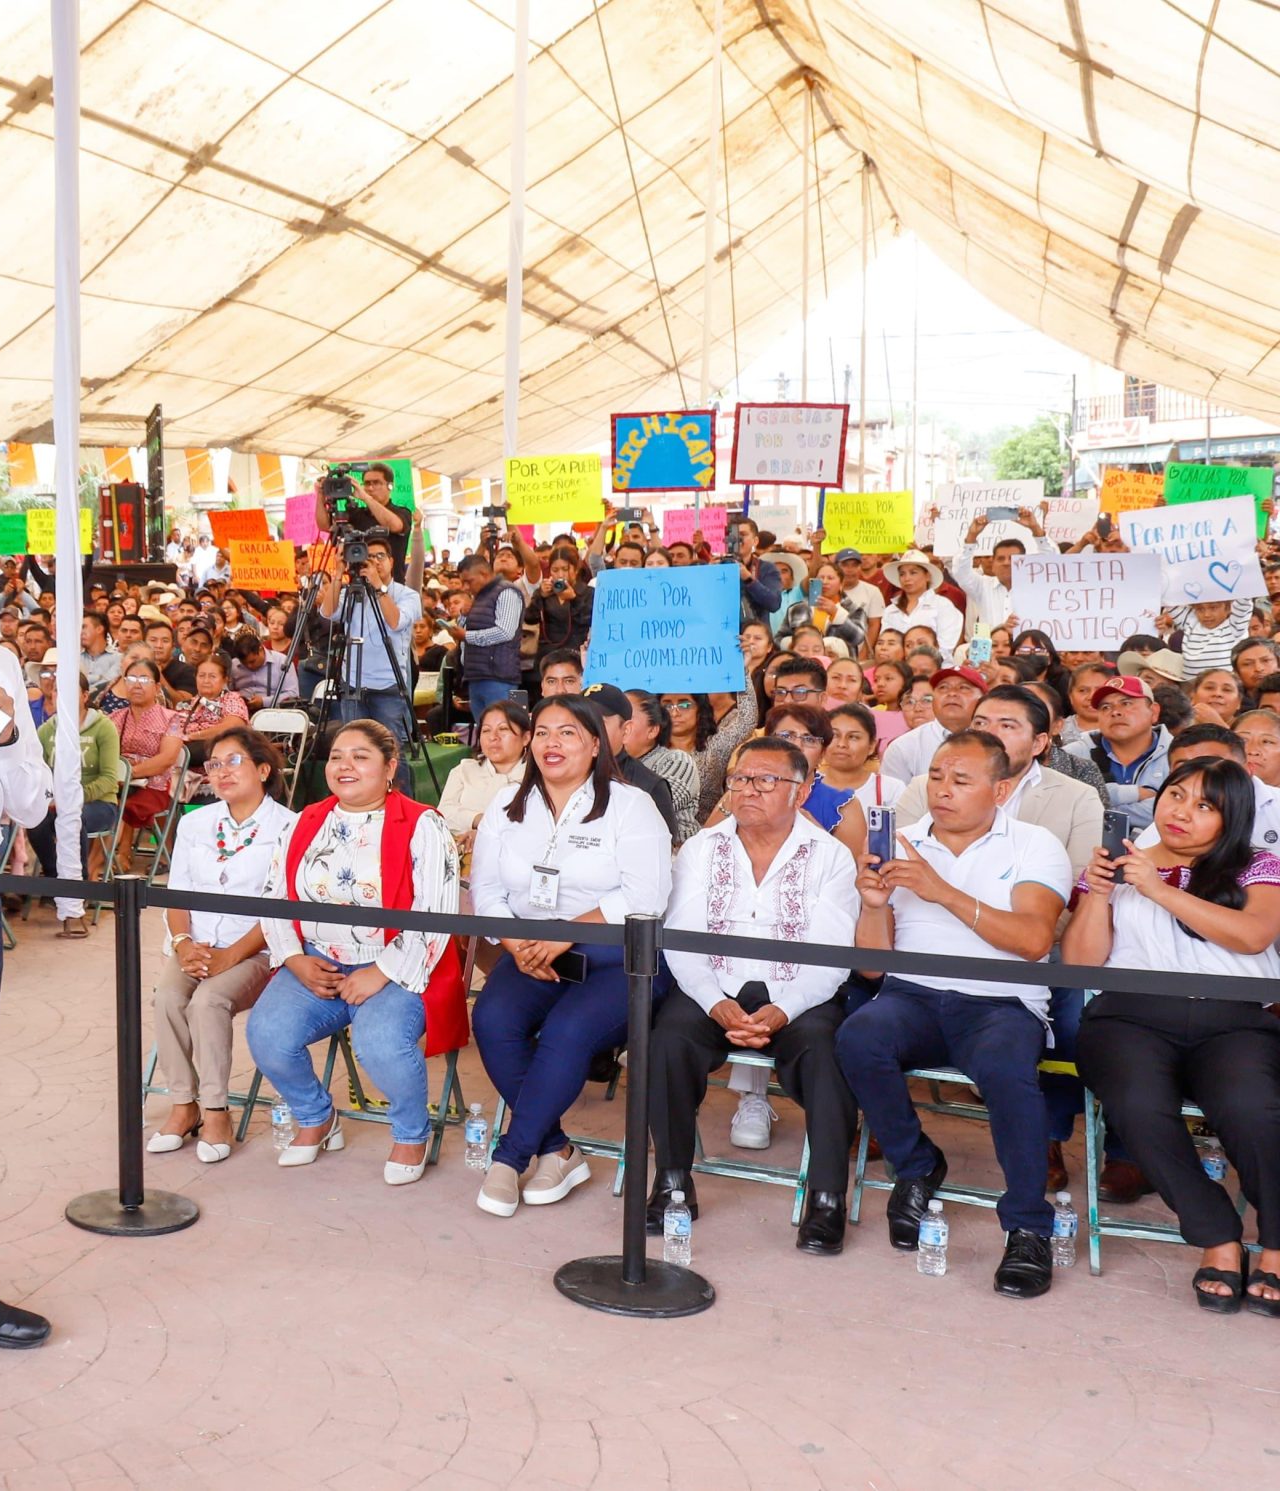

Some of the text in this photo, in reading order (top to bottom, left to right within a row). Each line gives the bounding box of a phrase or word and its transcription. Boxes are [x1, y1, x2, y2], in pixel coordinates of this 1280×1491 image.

[754, 432, 833, 449] POR SUS
[509, 459, 541, 478] POR
[507, 482, 540, 495] CINCO
[951, 483, 1022, 507] APIZTEPEC
[825, 499, 895, 515] GRACIAS POR
[1049, 499, 1082, 514] EBLO
[990, 522, 1007, 536] TU
[1129, 516, 1239, 547] POR AMOR A
[239, 542, 280, 554] GRACIAS
[231, 567, 290, 582] GOBERNADOR
[597, 581, 692, 620] GRACIAS POR
[1048, 586, 1116, 611] ESTA
[640, 618, 687, 641] APOYO
[590, 646, 724, 670] EN COYOMEAPAN
